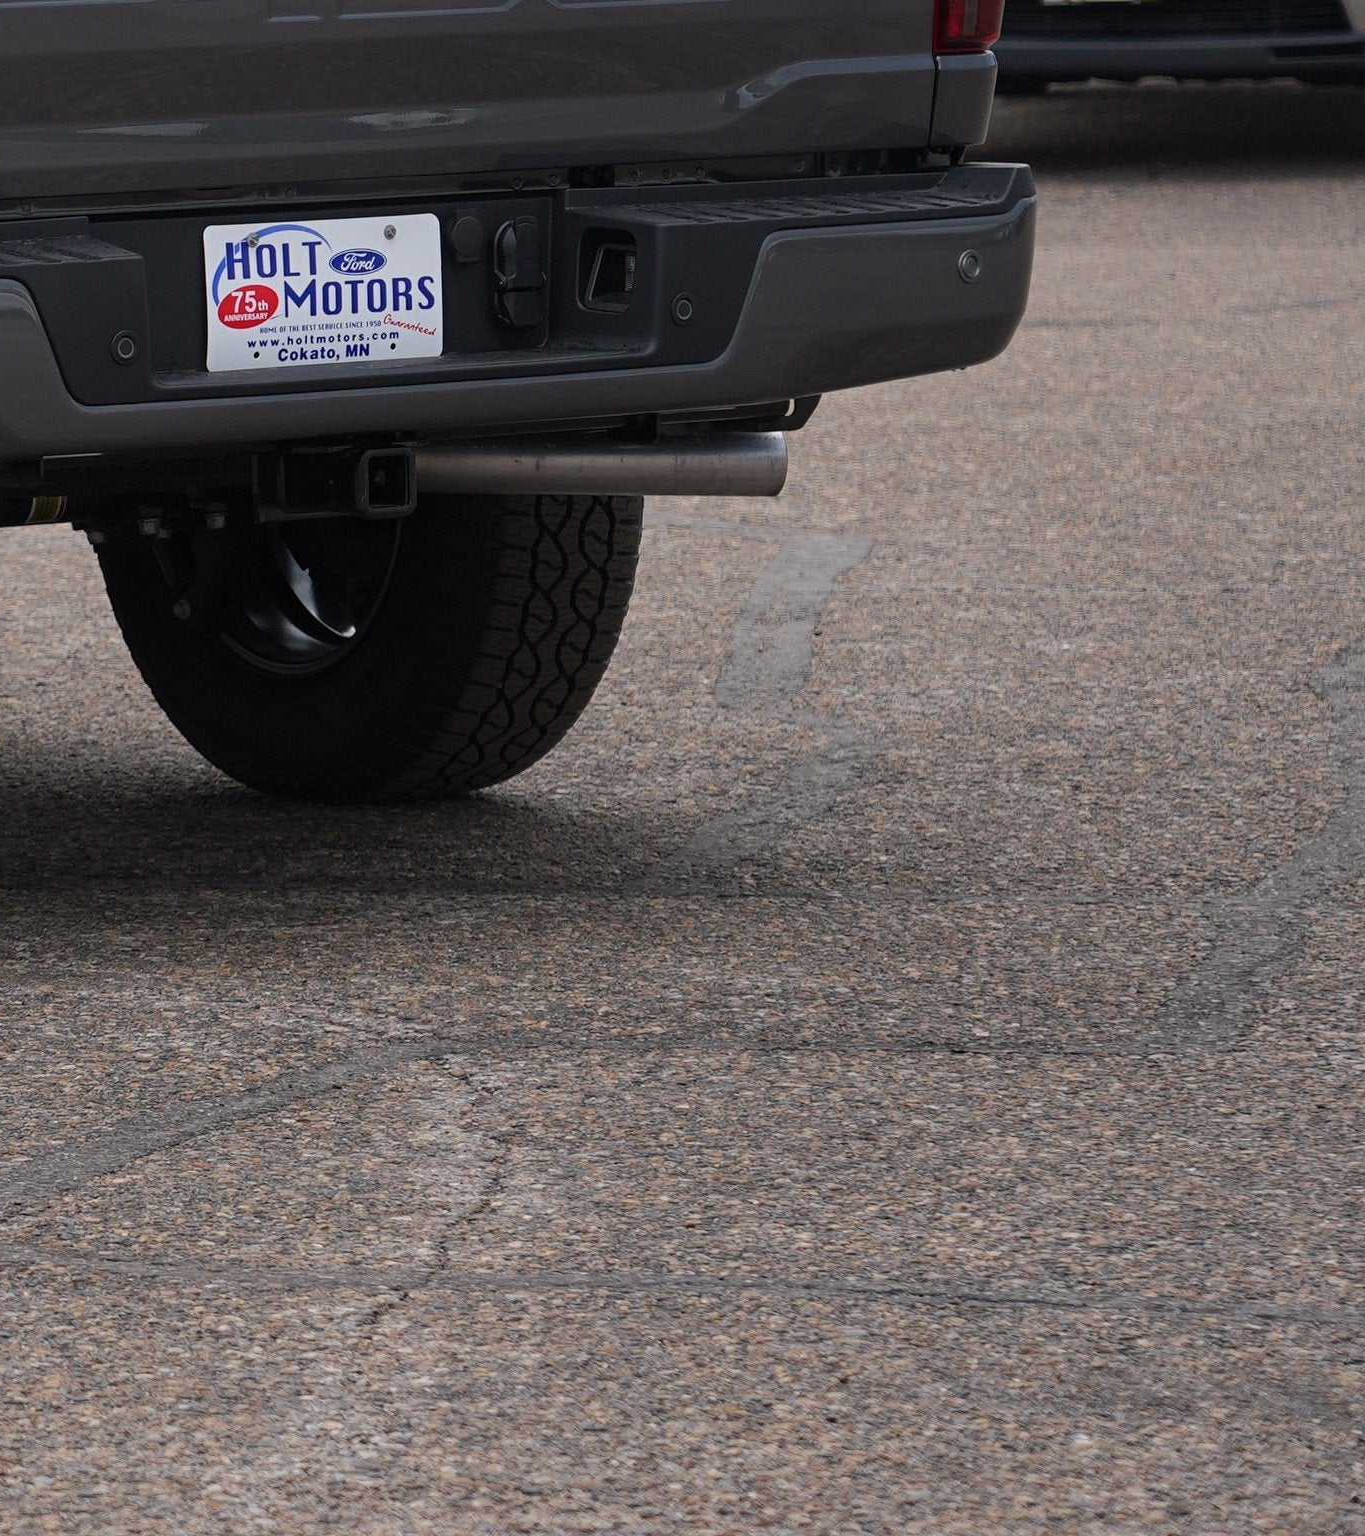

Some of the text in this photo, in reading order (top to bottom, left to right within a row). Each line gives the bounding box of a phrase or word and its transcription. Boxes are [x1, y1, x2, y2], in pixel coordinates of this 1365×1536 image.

[225, 240, 322, 280] HOLT
[231, 290, 269, 314] 75th
[283, 275, 435, 318] MOTORS
[224, 312, 268, 322] ANNIVERSARY
[383, 313, 437, 336] Guaranteed
[259, 326, 277, 334] HOME
[279, 325, 287, 333] OF
[345, 321, 364, 329] SINCE
[248, 331, 399, 348] www.holtmotors.com
[277, 343, 370, 361] Cokato, MN
